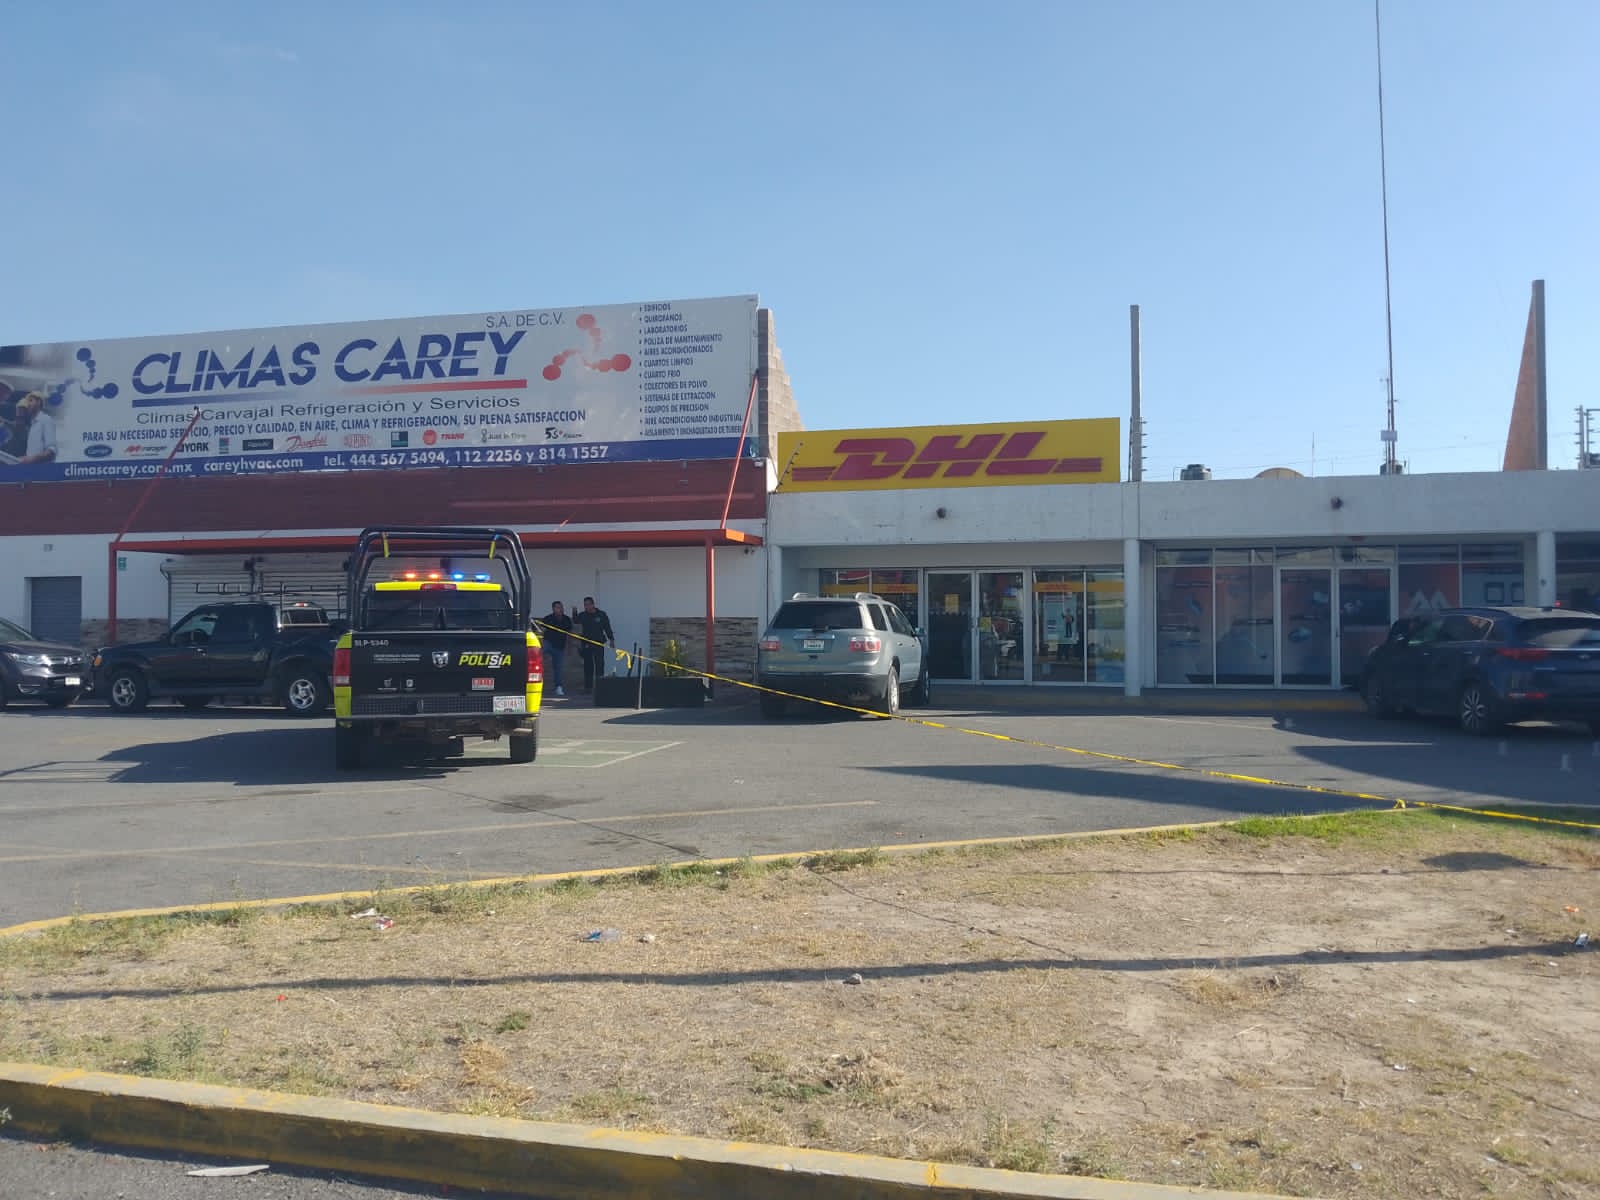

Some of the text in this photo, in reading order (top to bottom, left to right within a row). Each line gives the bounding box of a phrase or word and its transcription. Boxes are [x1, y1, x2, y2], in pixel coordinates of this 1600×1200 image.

[486, 312, 565, 329] S.A. DE C.V.
[644, 324, 688, 335] LABORATORIOS
[666, 336, 673, 344] DE
[674, 334, 723, 344] MANTENIMIENTO
[661, 345, 713, 355] ACONDICIONADOS
[132, 330, 527, 395] CLIMAS CAREY
[644, 359, 669, 368] CUARTOS
[644, 369, 681, 379] CUARTO FRIO
[644, 380, 708, 391] COLECTORES DE POLVO
[644, 391, 716, 402] SISTEMAS DE EXTRACCION
[136, 395, 520, 425] Climas Carvajal Refrigeración y Servicios
[644, 405, 669, 414] EQUIPOS
[671, 404, 678, 413] DE
[83, 431, 104, 442] PARA
[107, 431, 118, 441] SU
[120, 428, 167, 440] NECESIDAD
[170, 426, 211, 439] SERICIO,
[214, 425, 245, 436] PRECIO
[247, 424, 253, 434] Y
[255, 422, 297, 434] CALIDAD,
[300, 421, 312, 432] EN
[315, 419, 338, 432] AIRE,
[341, 418, 370, 430] CLIMA
[371, 418, 379, 429] Y
[463, 414, 476, 426] SU
[479, 413, 511, 425] PLENA
[514, 409, 586, 424] SATISFACCION
[185, 442, 209, 453] YORK
[324, 445, 609, 467] tel. 444 567 5494, 112 2256 y 814 1557
[833, 431, 1058, 481] DHL
[64, 457, 304, 478] climascarey.com.mx careyhvac.com
